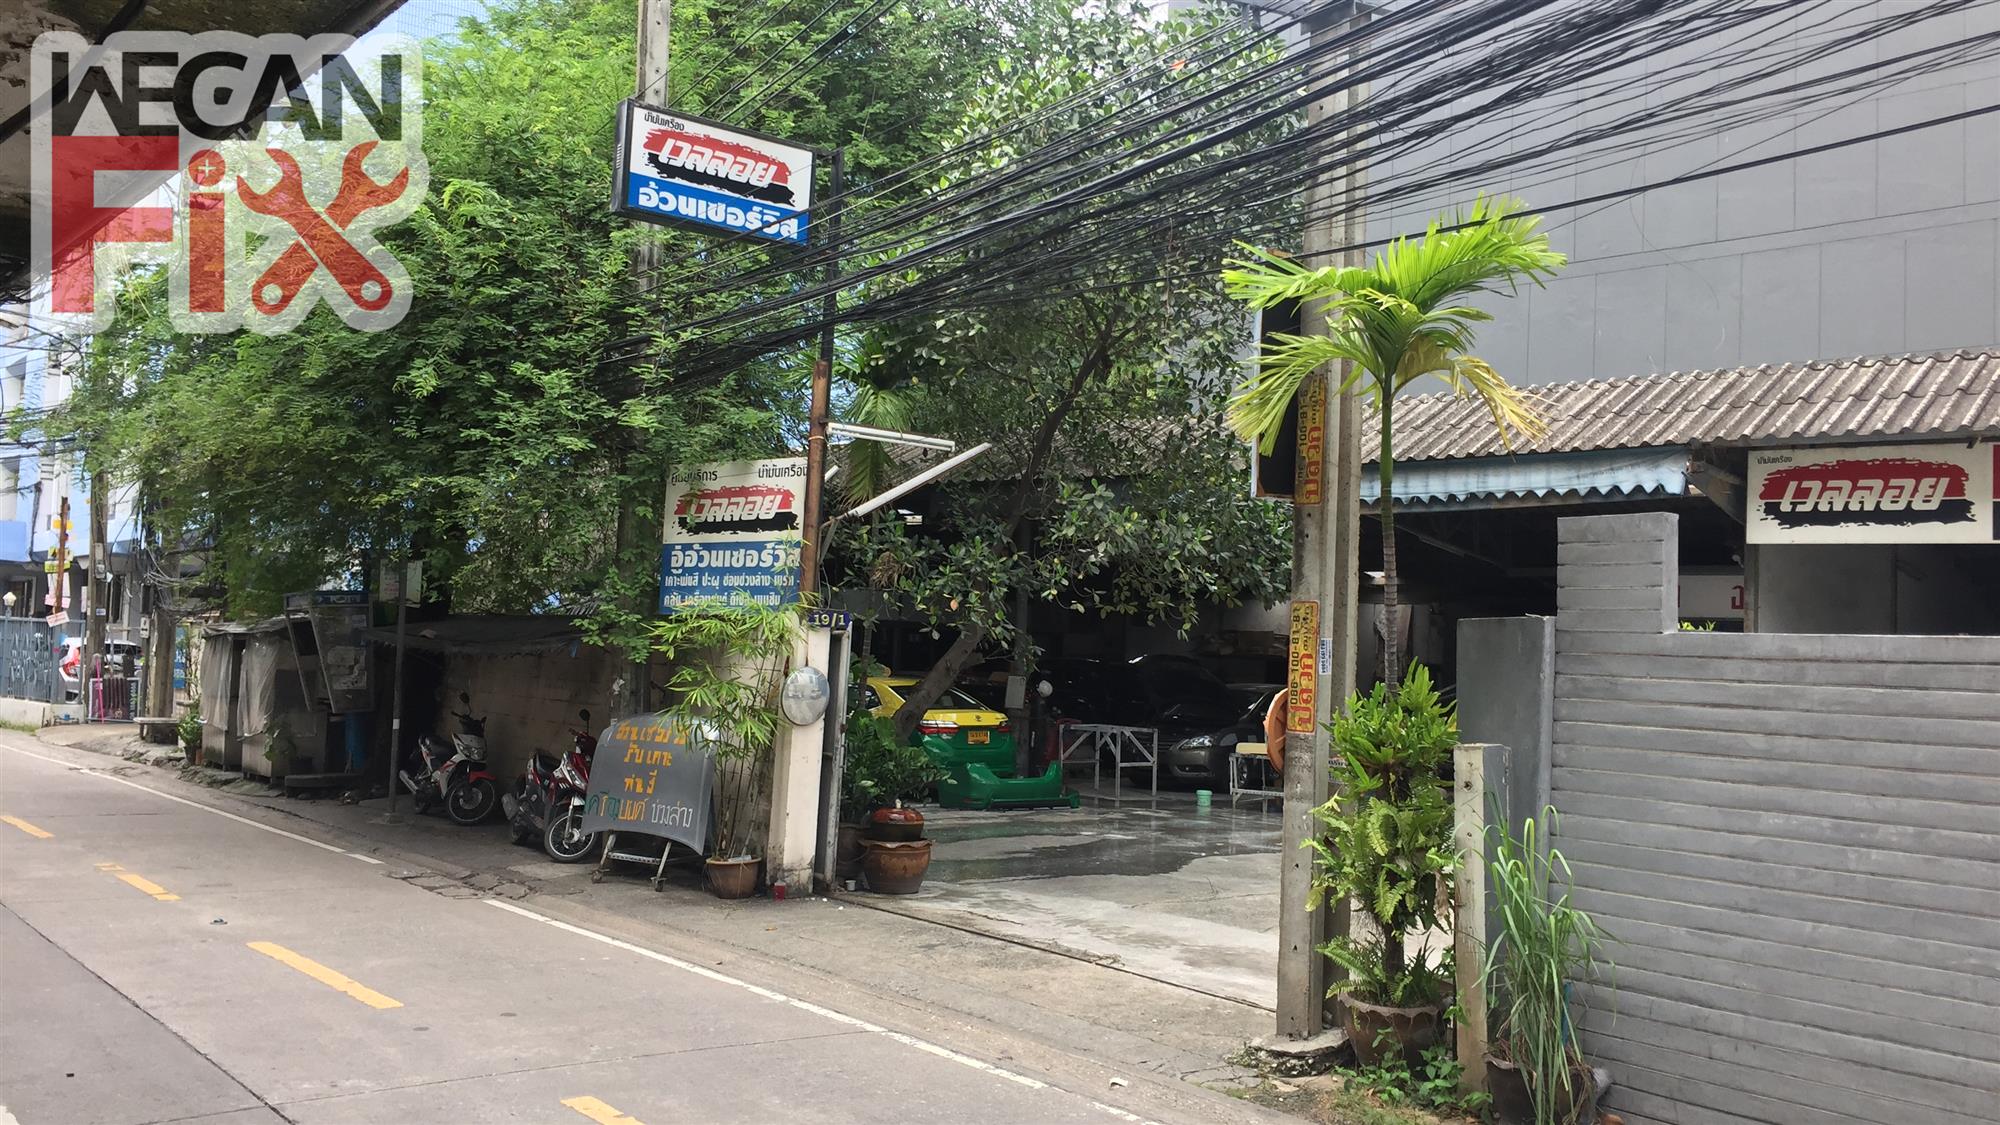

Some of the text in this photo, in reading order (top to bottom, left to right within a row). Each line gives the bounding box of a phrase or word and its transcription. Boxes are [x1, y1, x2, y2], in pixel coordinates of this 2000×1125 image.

[658, 138, 778, 188] เวลลอย
[1779, 477, 1951, 512] เวลลอย
[814, 613, 845, 627] 19/1
[1290, 653, 1313, 726] ปลวก
